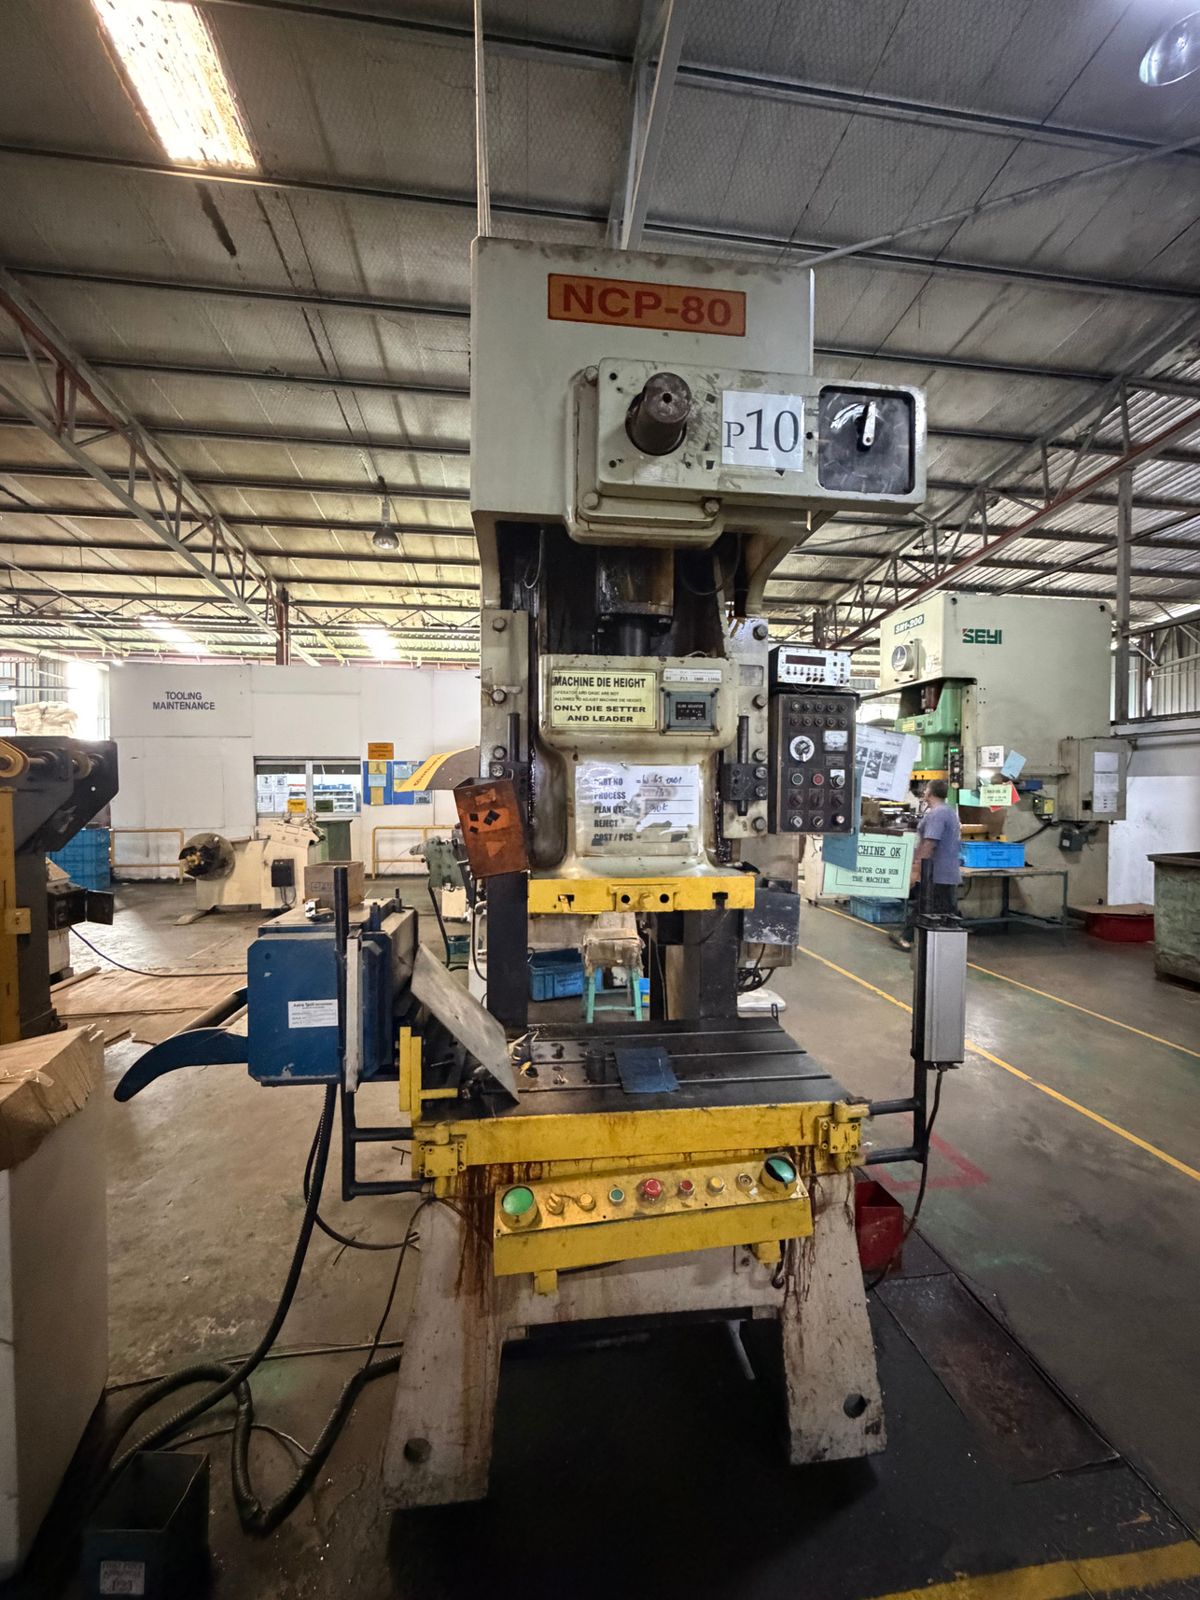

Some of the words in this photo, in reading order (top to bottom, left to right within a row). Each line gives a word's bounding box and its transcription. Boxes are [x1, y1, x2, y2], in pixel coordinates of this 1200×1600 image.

[562, 283, 732, 327] NCP-80
[723, 408, 799, 453] P10
[553, 676, 594, 687] MACHINE
[596, 677, 611, 687] DIE
[613, 677, 646, 688] HEIGHT
[165, 691, 202, 700] TOOLING
[152, 701, 216, 711] MAINTENANCE
[553, 704, 582, 712] ONLY
[592, 715, 634, 723] LEADER
[613, 777, 623, 786] NO
[594, 791, 626, 800] PROCESS
[594, 805, 611, 814] PLAN
[594, 819, 618, 828] REJECT
[593, 833, 612, 841] COST
[619, 833, 633, 841] PCS
[857, 845, 886, 856] CHINE
[890, 847, 902, 857] OK
[875, 867, 886, 875] CAN
[866, 876, 891, 884] MACHINE
